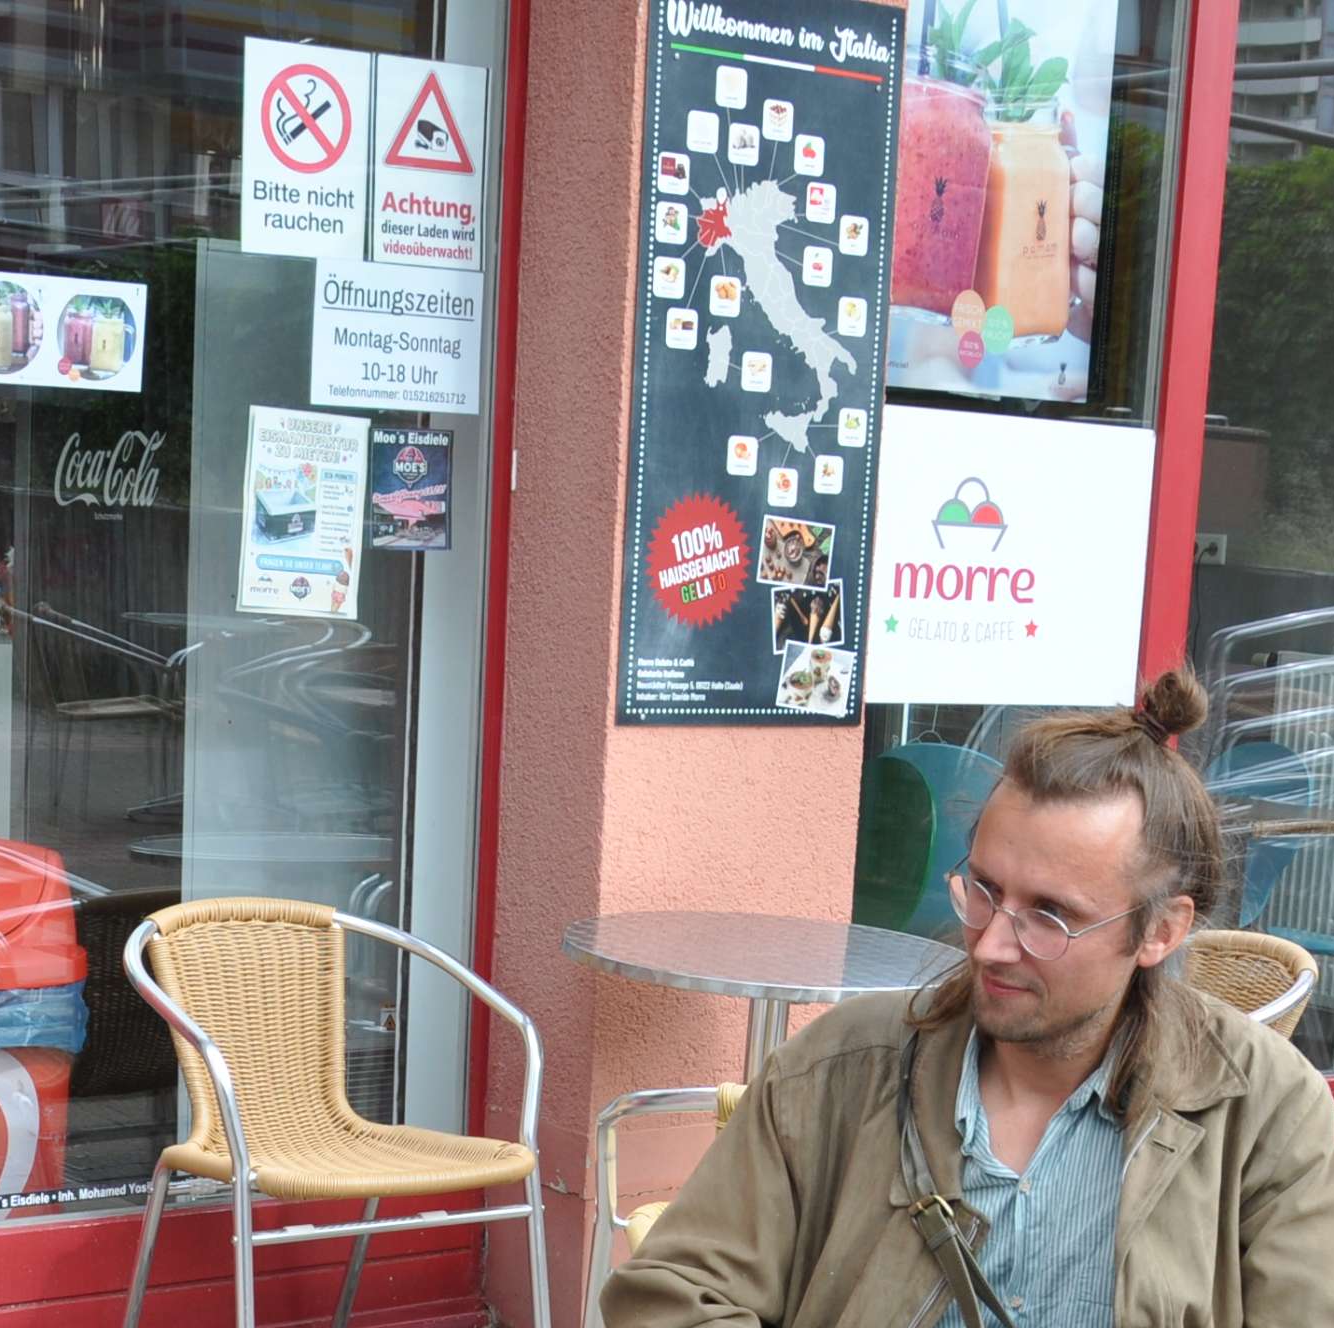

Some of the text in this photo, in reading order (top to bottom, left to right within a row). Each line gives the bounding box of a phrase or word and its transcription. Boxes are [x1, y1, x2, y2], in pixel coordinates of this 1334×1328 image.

[667, 0, 891, 63] Willkommen im Italia
[253, 180, 354, 209] Bitte nicht
[381, 191, 476, 225] Achtung,
[264, 212, 343, 234] rauchen
[381, 219, 475, 242] dieser Laden wird
[383, 241, 473, 261] videoüberwacht!
[323, 273, 475, 316] Öffnungszeiten
[334, 327, 461, 359] Montag-Sonntag
[361, 362, 438, 385] 10-18 Uhr
[329, 384, 401, 401] Telefonnummer:
[408, 432, 449, 447] Eisdiele
[54, 430, 167, 507] Coca-Cola
[671, 522, 723, 562] 100%
[658, 546, 740, 589] HAUSGEMACHT
[893, 561, 1035, 603] morre
[681, 573, 727, 604] GELATO
[908, 617, 957, 642] GELATO
[10, 1192, 51, 1208] Eisdiele
[58, 1188, 76, 1203] Inh.
[78, 1184, 127, 1201] Mohamed
